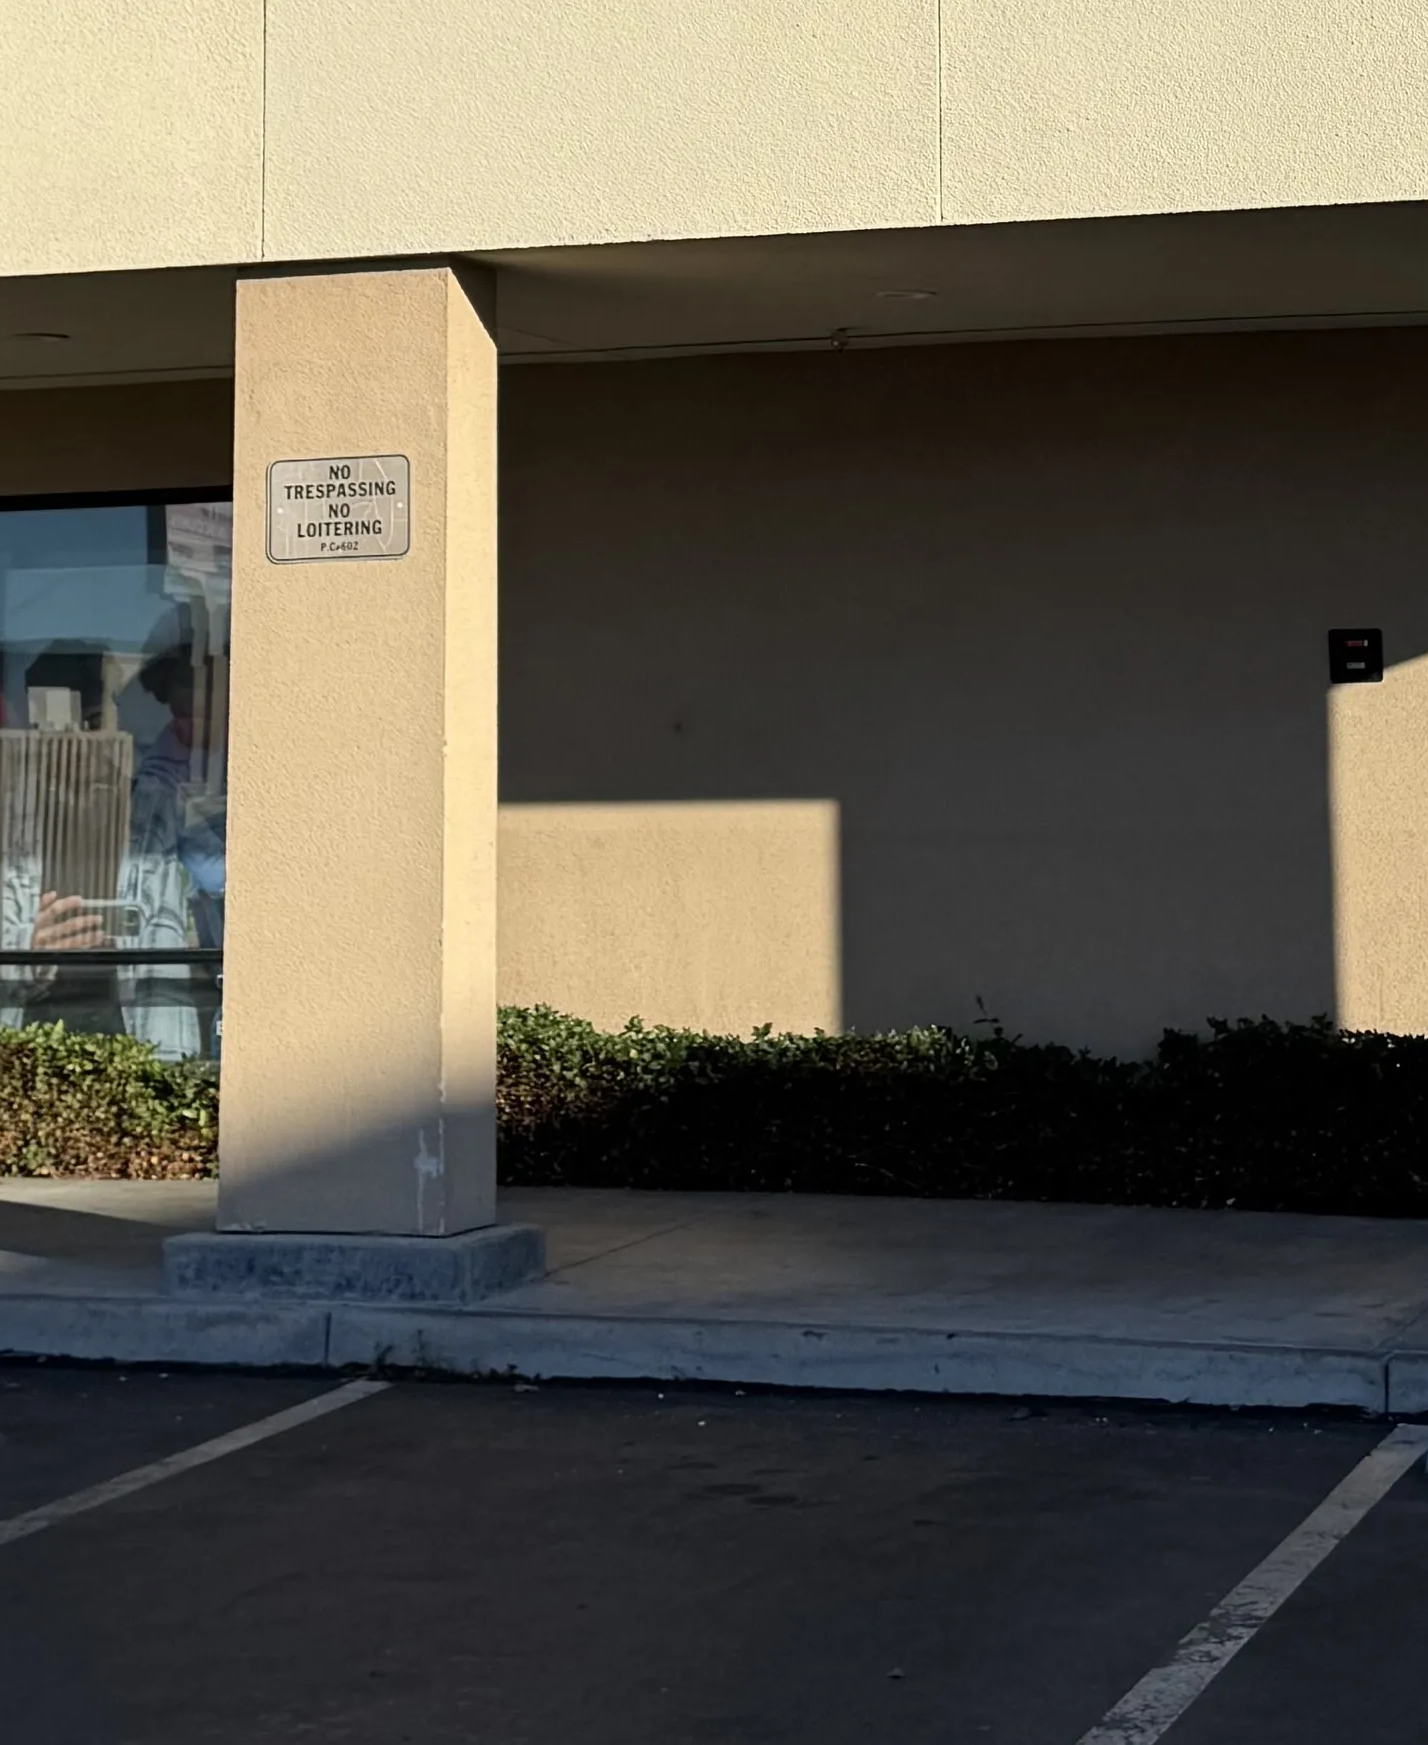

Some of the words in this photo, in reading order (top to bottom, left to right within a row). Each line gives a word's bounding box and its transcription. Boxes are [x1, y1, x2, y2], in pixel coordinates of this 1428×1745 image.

[329, 464, 351, 480] NO
[284, 480, 396, 500] TRESPASSING
[328, 502, 350, 518] NO
[297, 519, 382, 538] LOITERING
